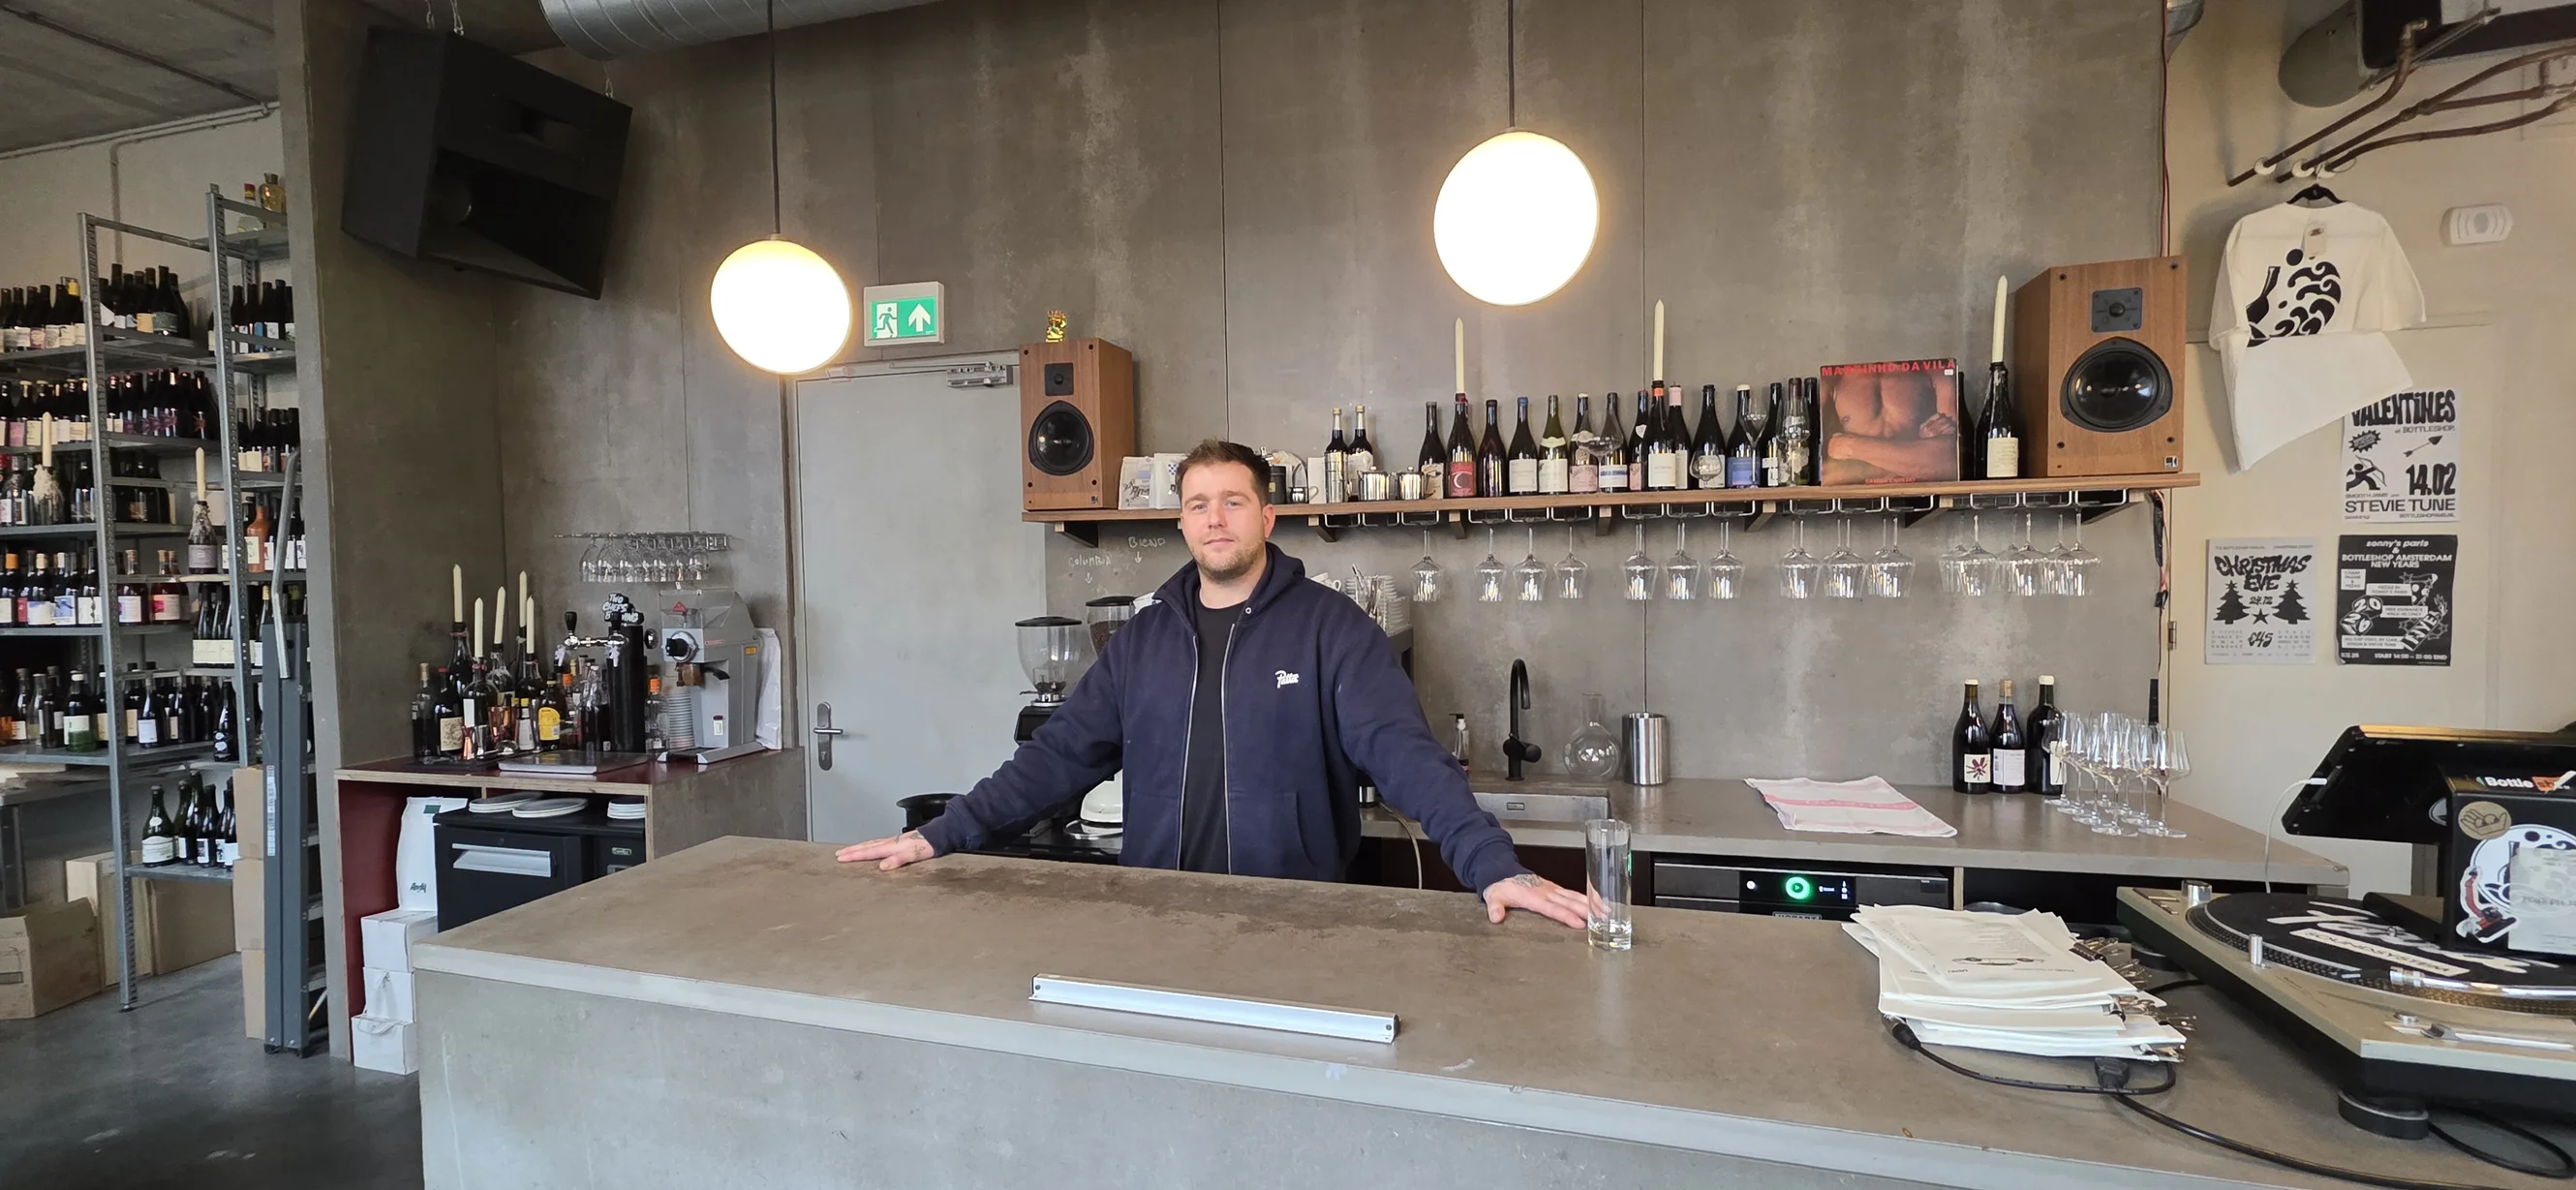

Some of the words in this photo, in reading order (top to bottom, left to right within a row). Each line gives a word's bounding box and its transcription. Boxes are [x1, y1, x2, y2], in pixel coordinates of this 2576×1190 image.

[1922, 359, 1955, 371] VILA
[2406, 462, 2456, 495] 14.02
[2345, 500, 2406, 513] STEVIE
[2408, 498, 2456, 511] TUNE
[2244, 574, 2282, 592] EVE
[605, 611, 639, 623] BWING
[2484, 777, 2533, 788] Bottle
